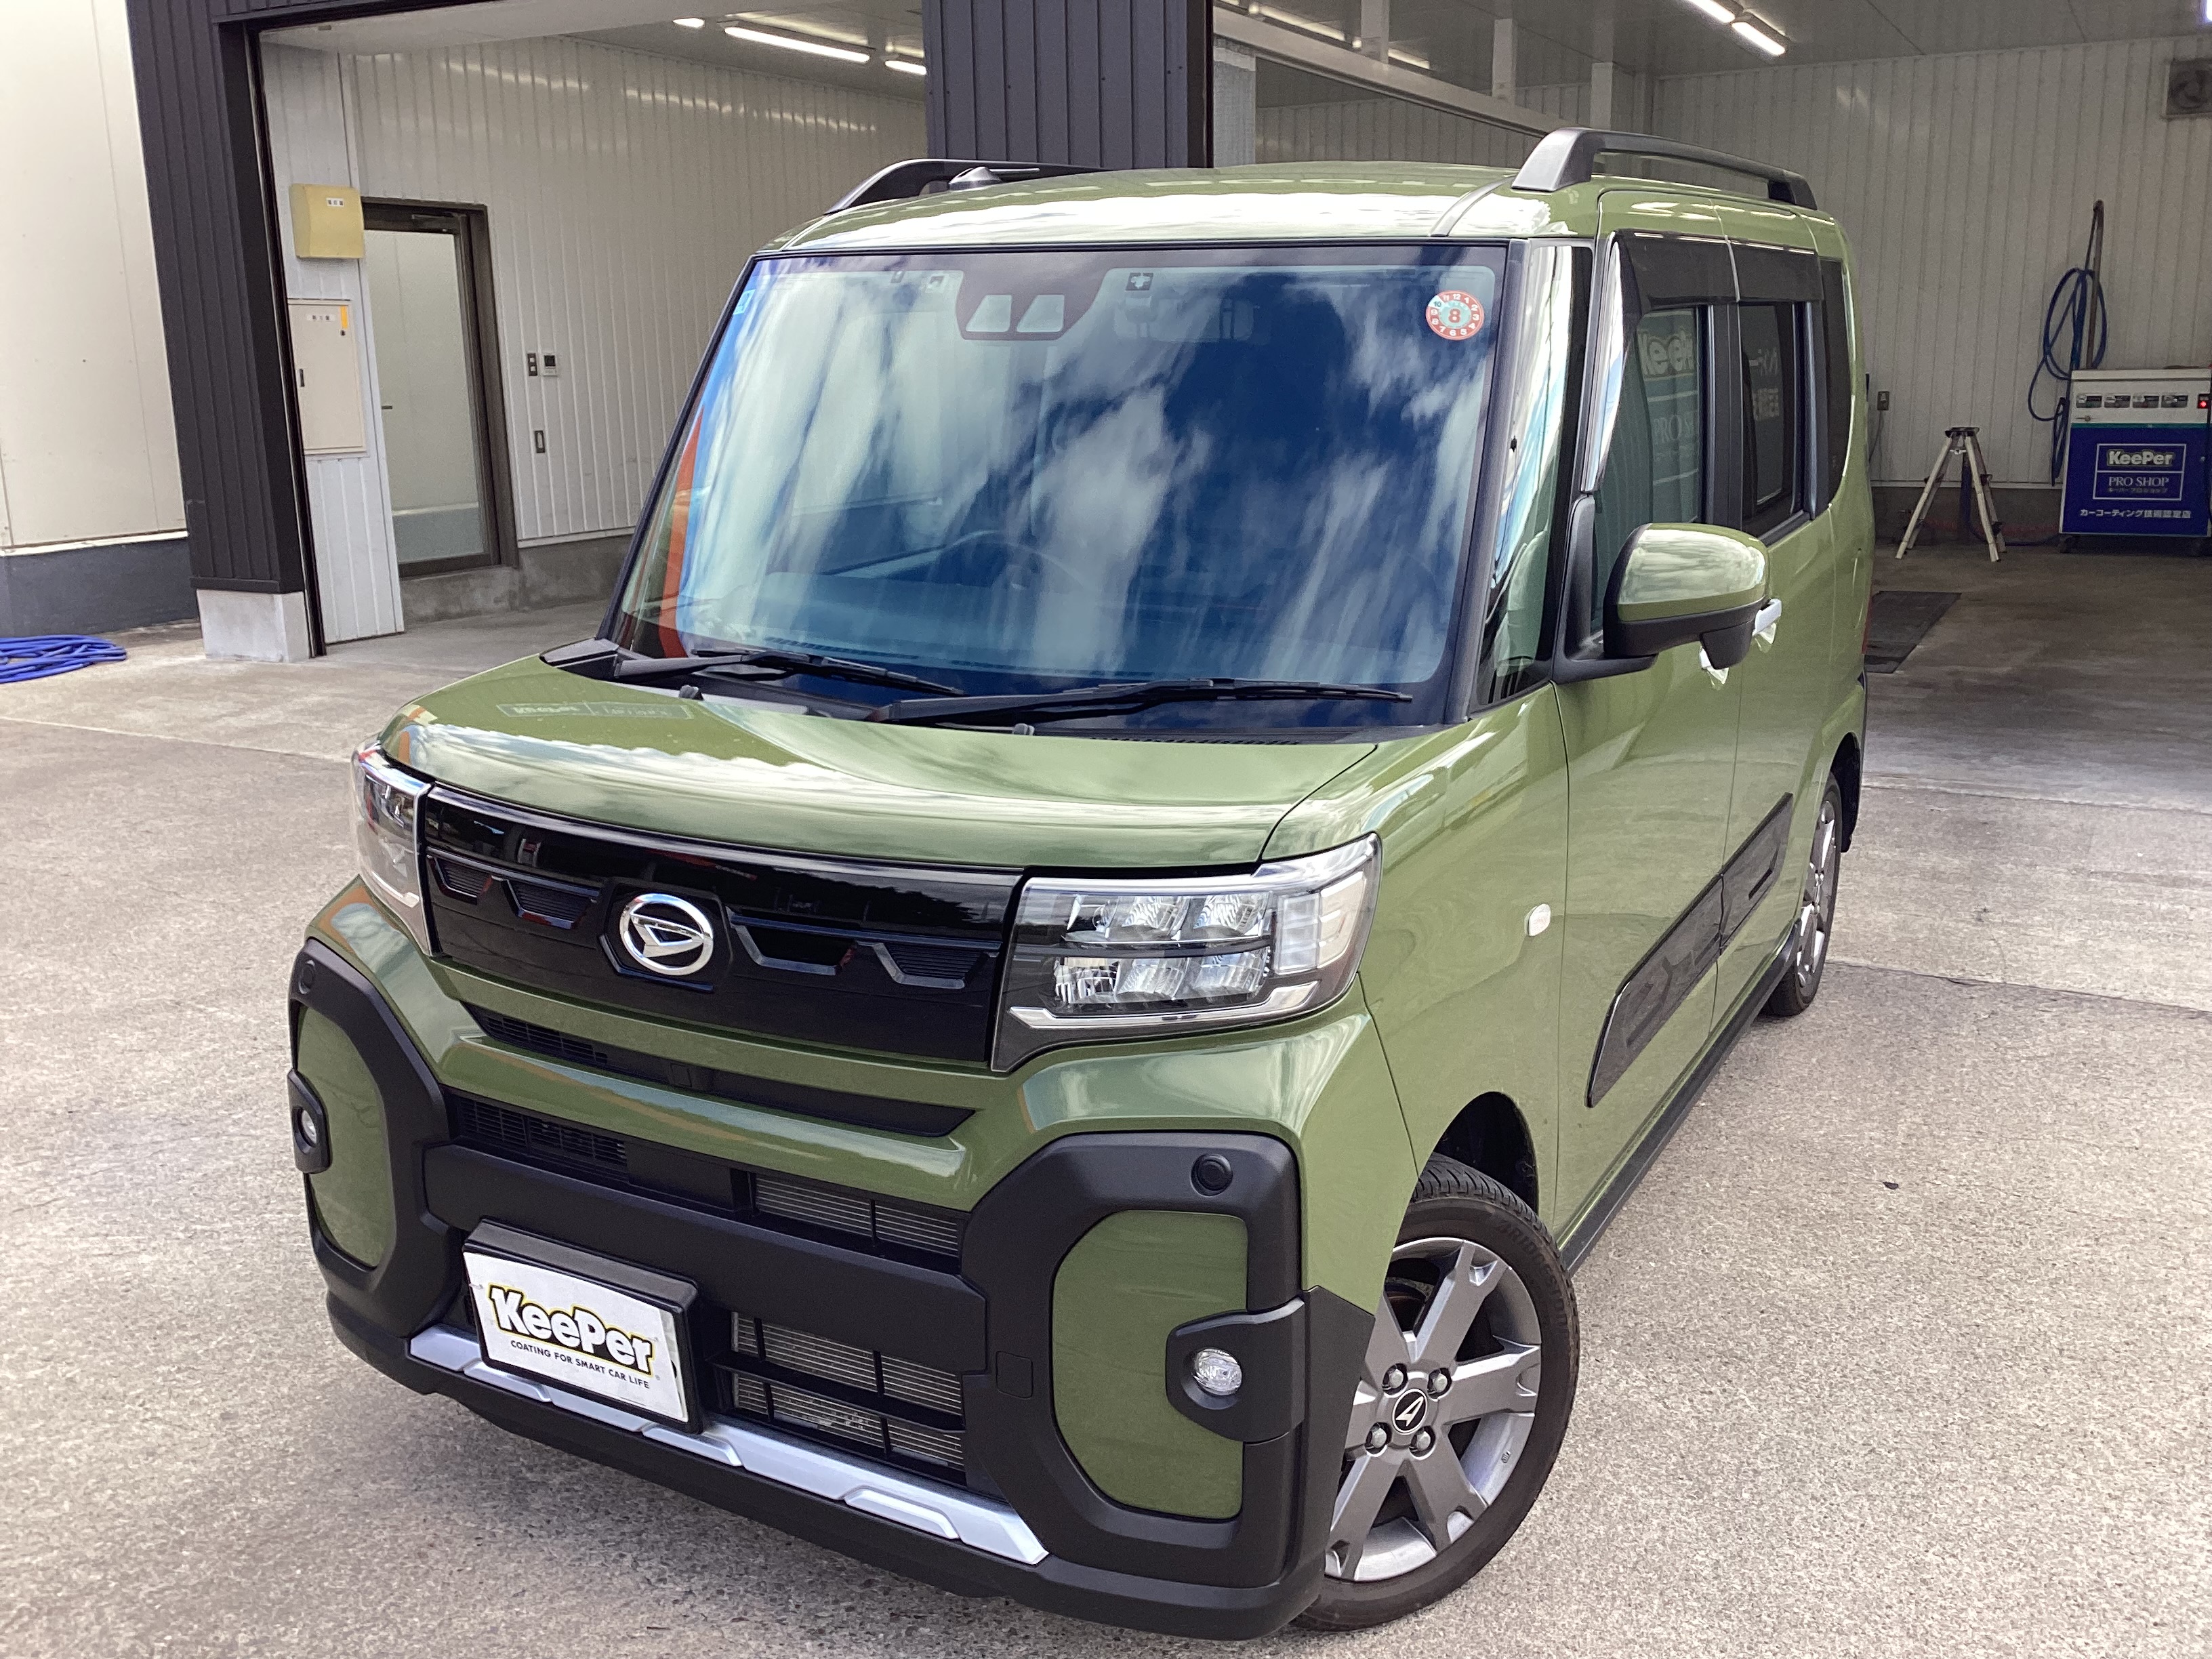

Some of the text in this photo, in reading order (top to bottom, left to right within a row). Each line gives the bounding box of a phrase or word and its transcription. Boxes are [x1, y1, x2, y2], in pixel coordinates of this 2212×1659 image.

[1448, 308, 1461, 323] 8
[2108, 449, 2175, 466] KeePer
[2108, 476, 2169, 487] PRO SHOP
[488, 1284, 654, 1376] KeePer
[510, 1339, 650, 1389] COATING FOR SMART CAR LIFE
